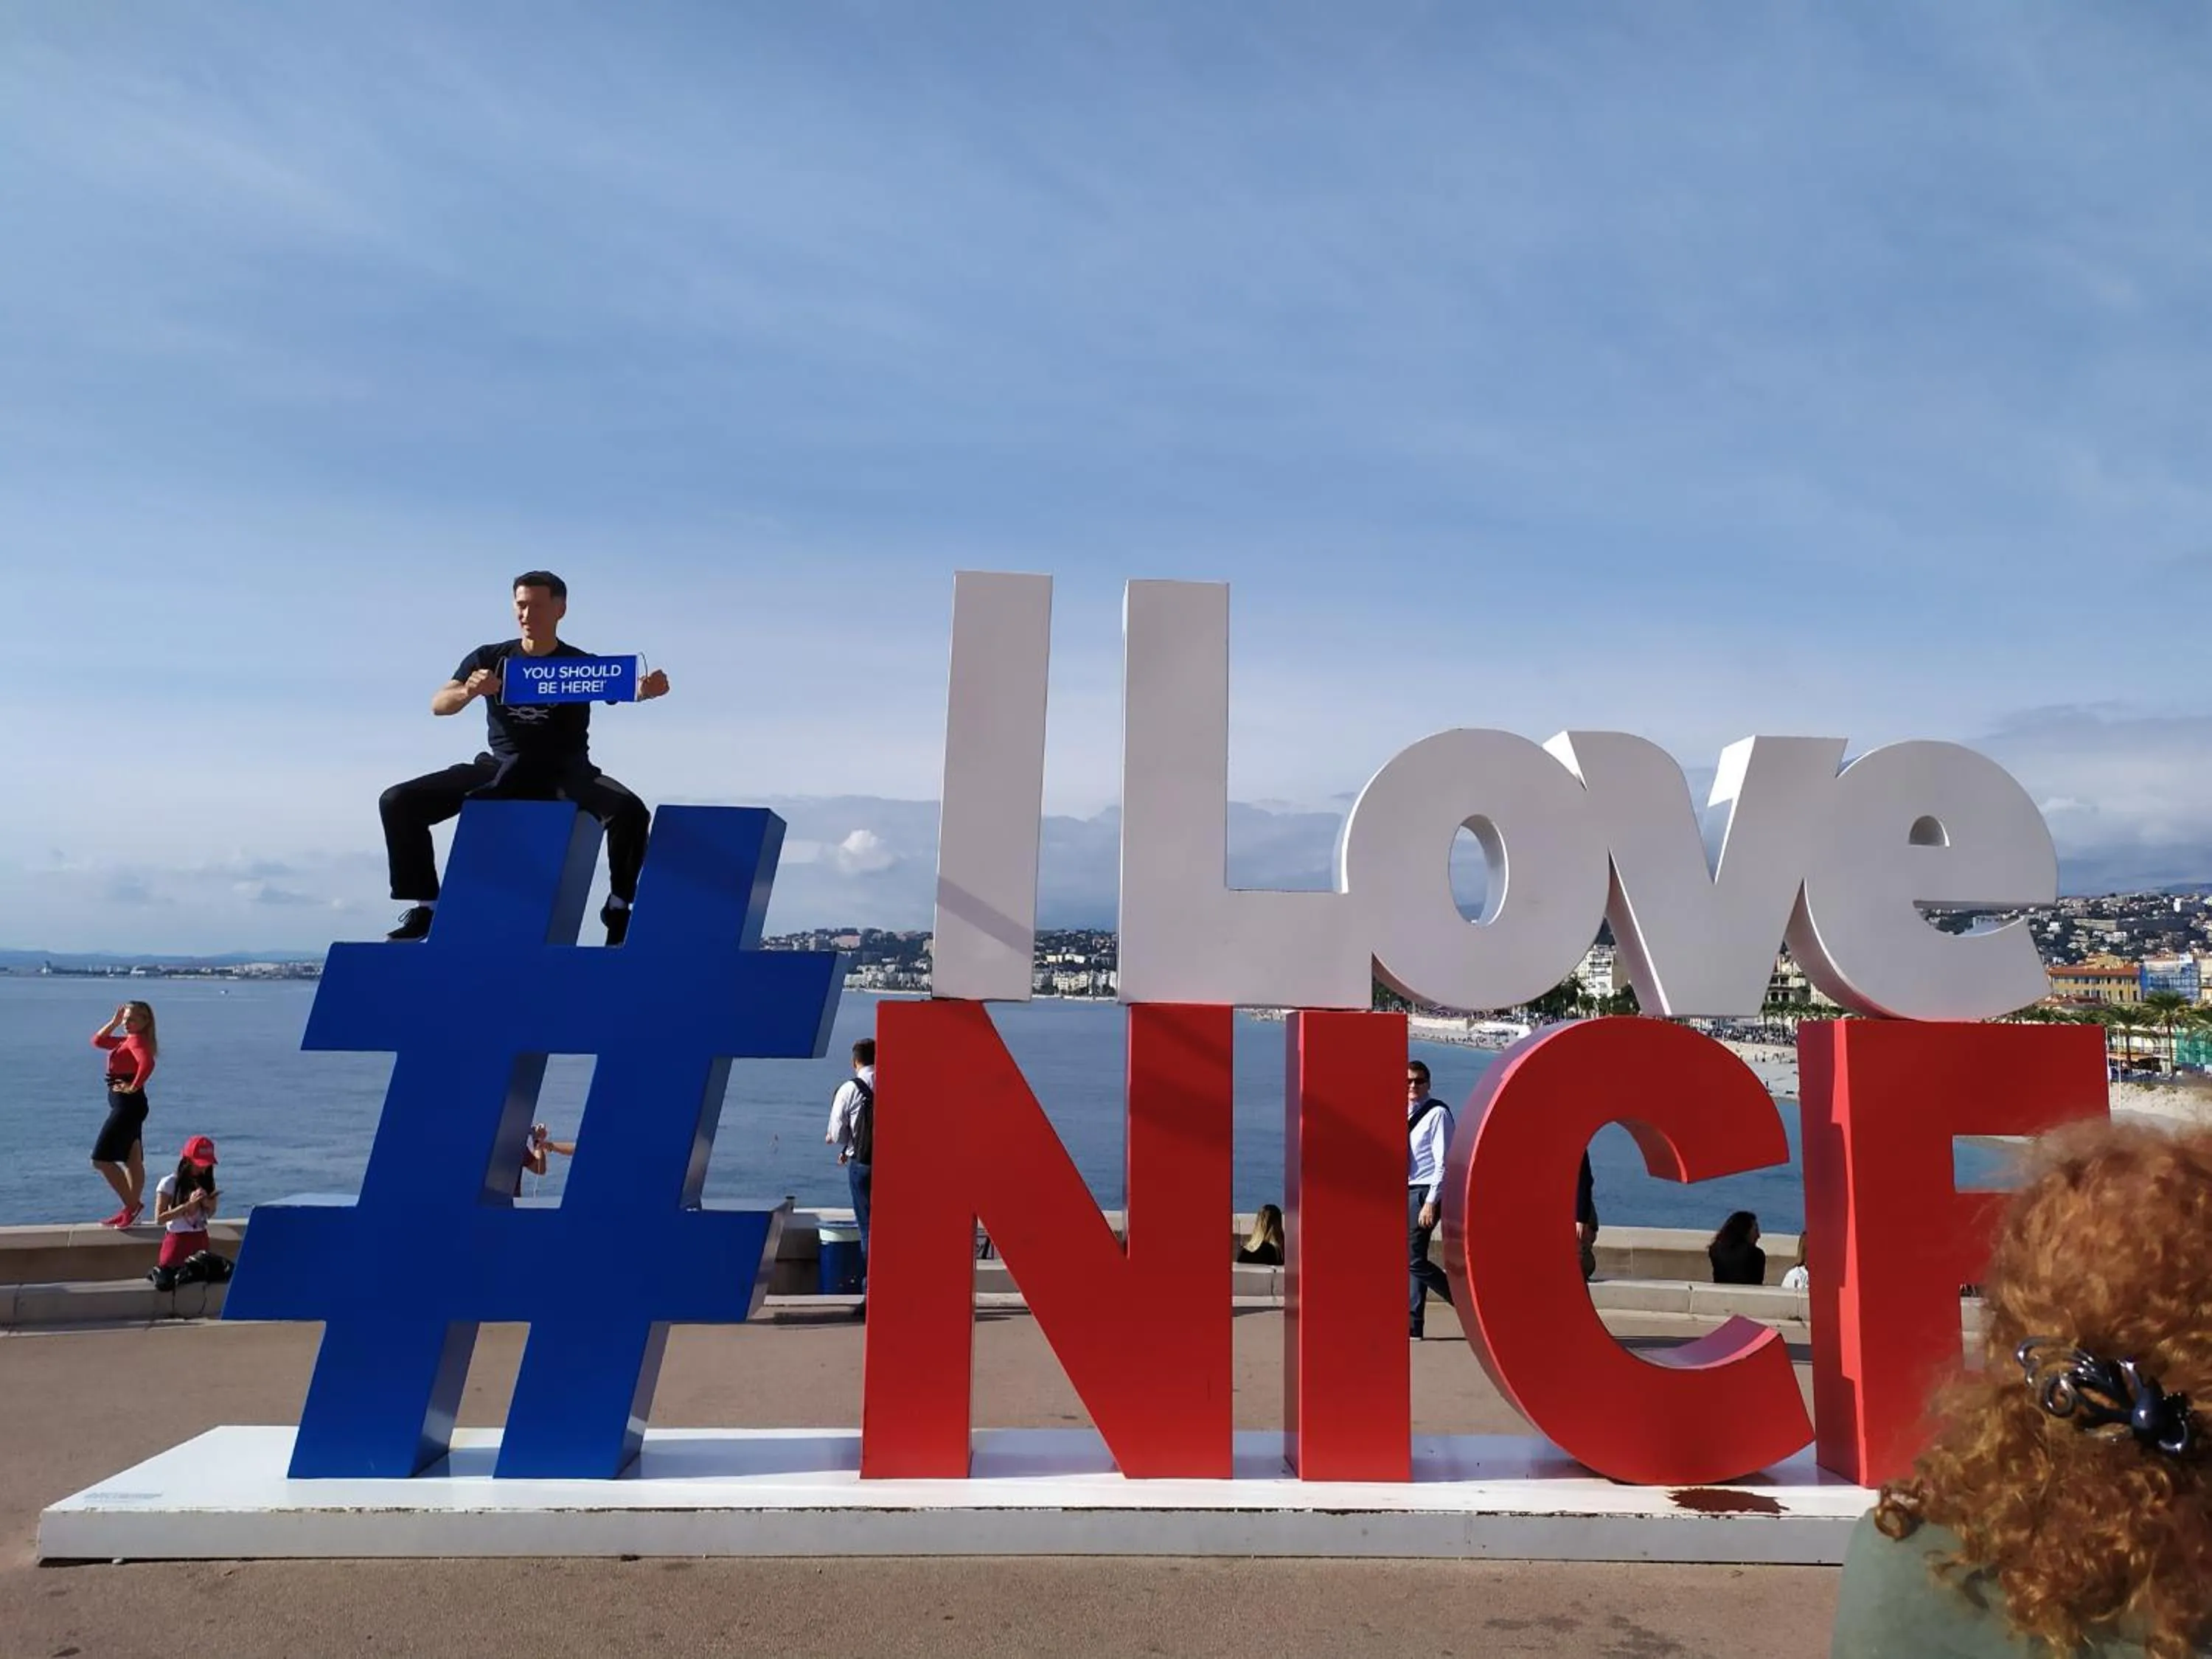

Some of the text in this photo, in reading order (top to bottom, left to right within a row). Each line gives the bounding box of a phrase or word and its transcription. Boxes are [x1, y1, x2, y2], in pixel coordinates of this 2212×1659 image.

[523, 664, 622, 679] YOU SHOULD
[538, 681, 605, 694] BE HERE!
[931, 570, 2059, 1020] I Love
